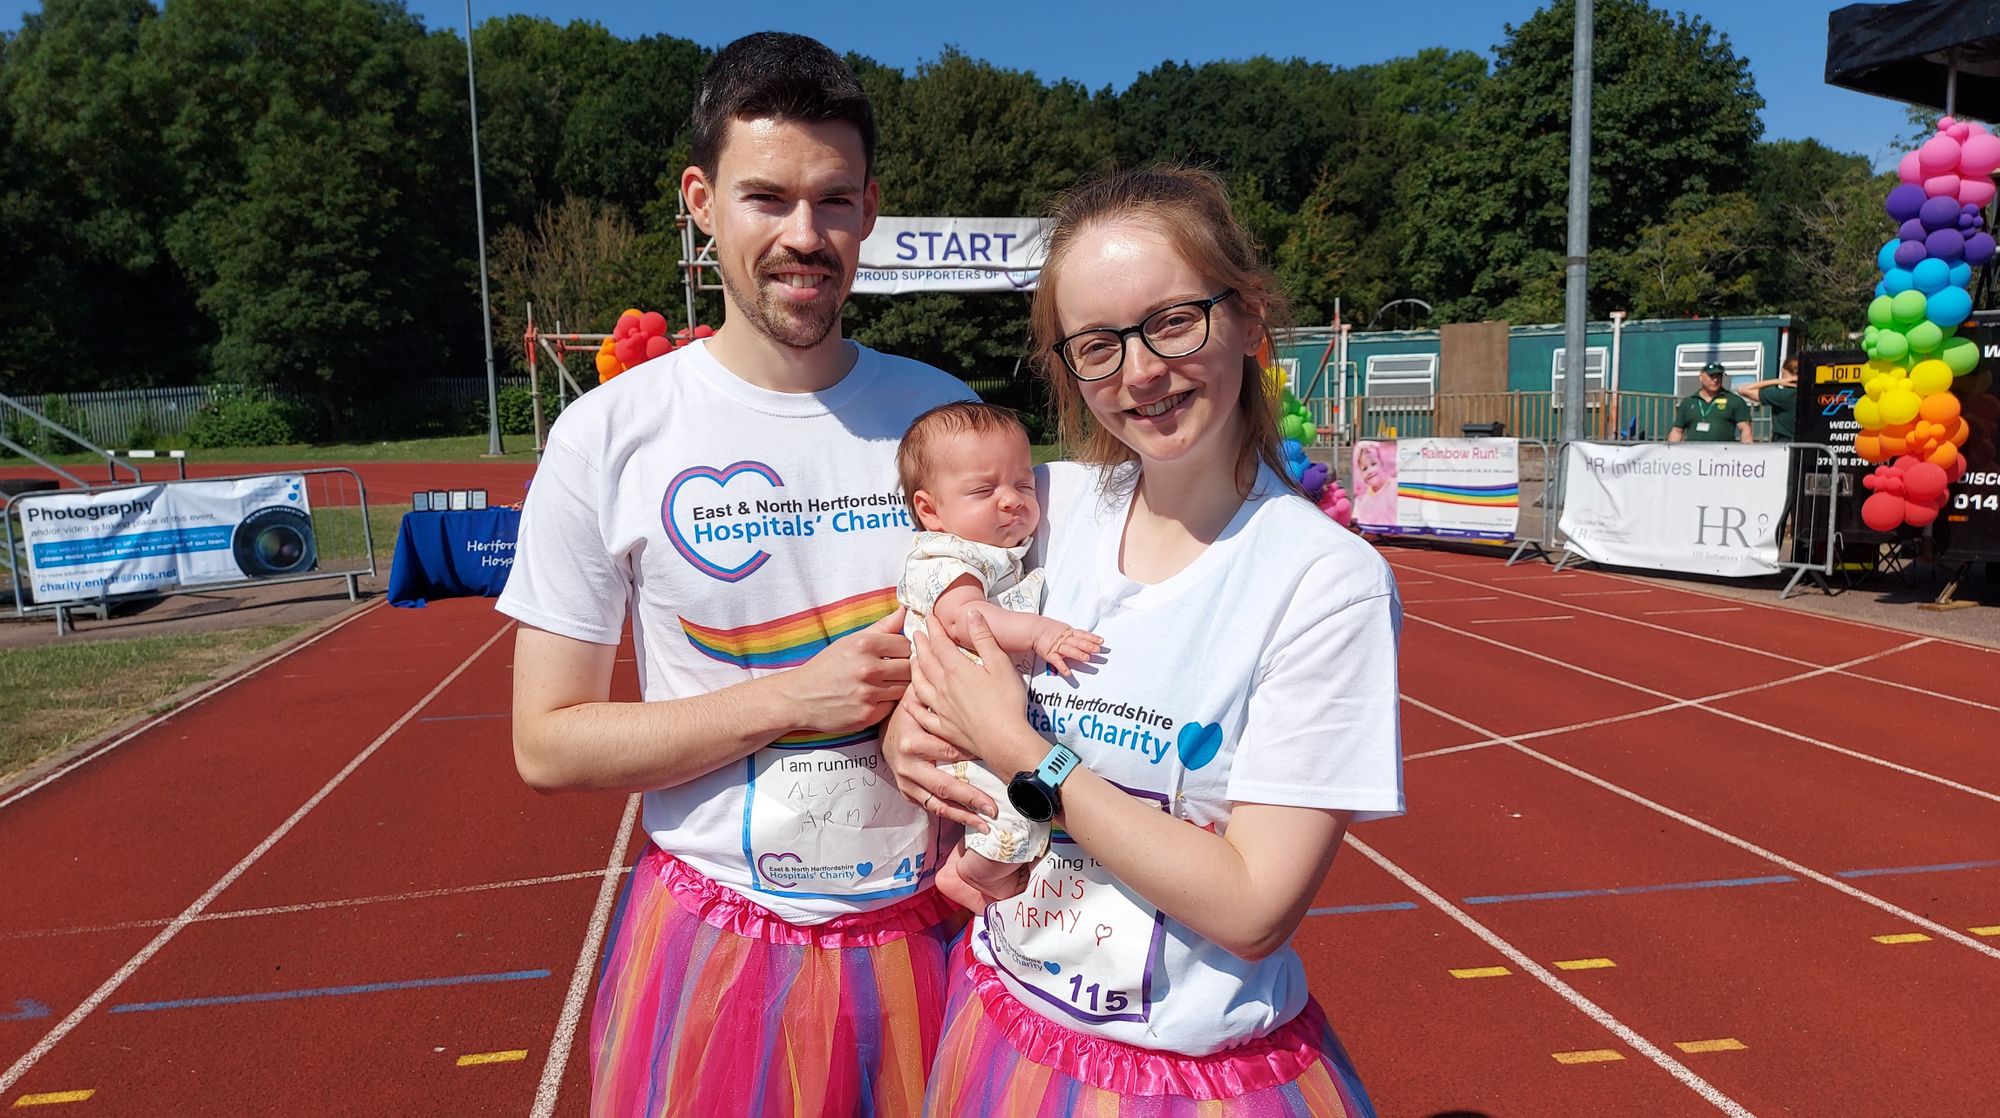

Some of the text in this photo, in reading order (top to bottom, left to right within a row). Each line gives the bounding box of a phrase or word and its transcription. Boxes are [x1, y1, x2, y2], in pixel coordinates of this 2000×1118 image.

[896, 231, 1017, 262] START
[856, 270, 1000, 281] PROUD SUPPORTERS OF
[1421, 447, 1469, 459] Rainbow
[1472, 447, 1498, 459] Run!
[1585, 456, 1766, 478] HR Initiatives Limited
[28, 500, 154, 522] Photography
[692, 504, 732, 521] East
[737, 501, 751, 516] &
[756, 497, 803, 514] North
[63, 524, 89, 534] video
[92, 523, 99, 532] is
[133, 517, 158, 528] place
[160, 516, 168, 524] at
[170, 514, 187, 522] this
[189, 513, 216, 521] event.
[693, 514, 822, 544] Hospitals'
[1693, 505, 1752, 548] HR
[482, 555, 514, 568] Hosp
[1065, 694, 1174, 730] Hertfordshire
[1027, 704, 1172, 765] itals' Charity
[781, 754, 878, 773] I am running
[803, 802, 881, 828] ARMY
[791, 865, 810, 873] North
[811, 864, 854, 872] Hertfordshire
[1048, 855, 1084, 872] ning
[769, 870, 855, 881] Hospitals' Charity
[1029, 873, 1085, 900] IN'S
[1014, 901, 1082, 934] ARMY
[1011, 953, 1043, 971] Charity
[1069, 973, 1129, 1012] 115
